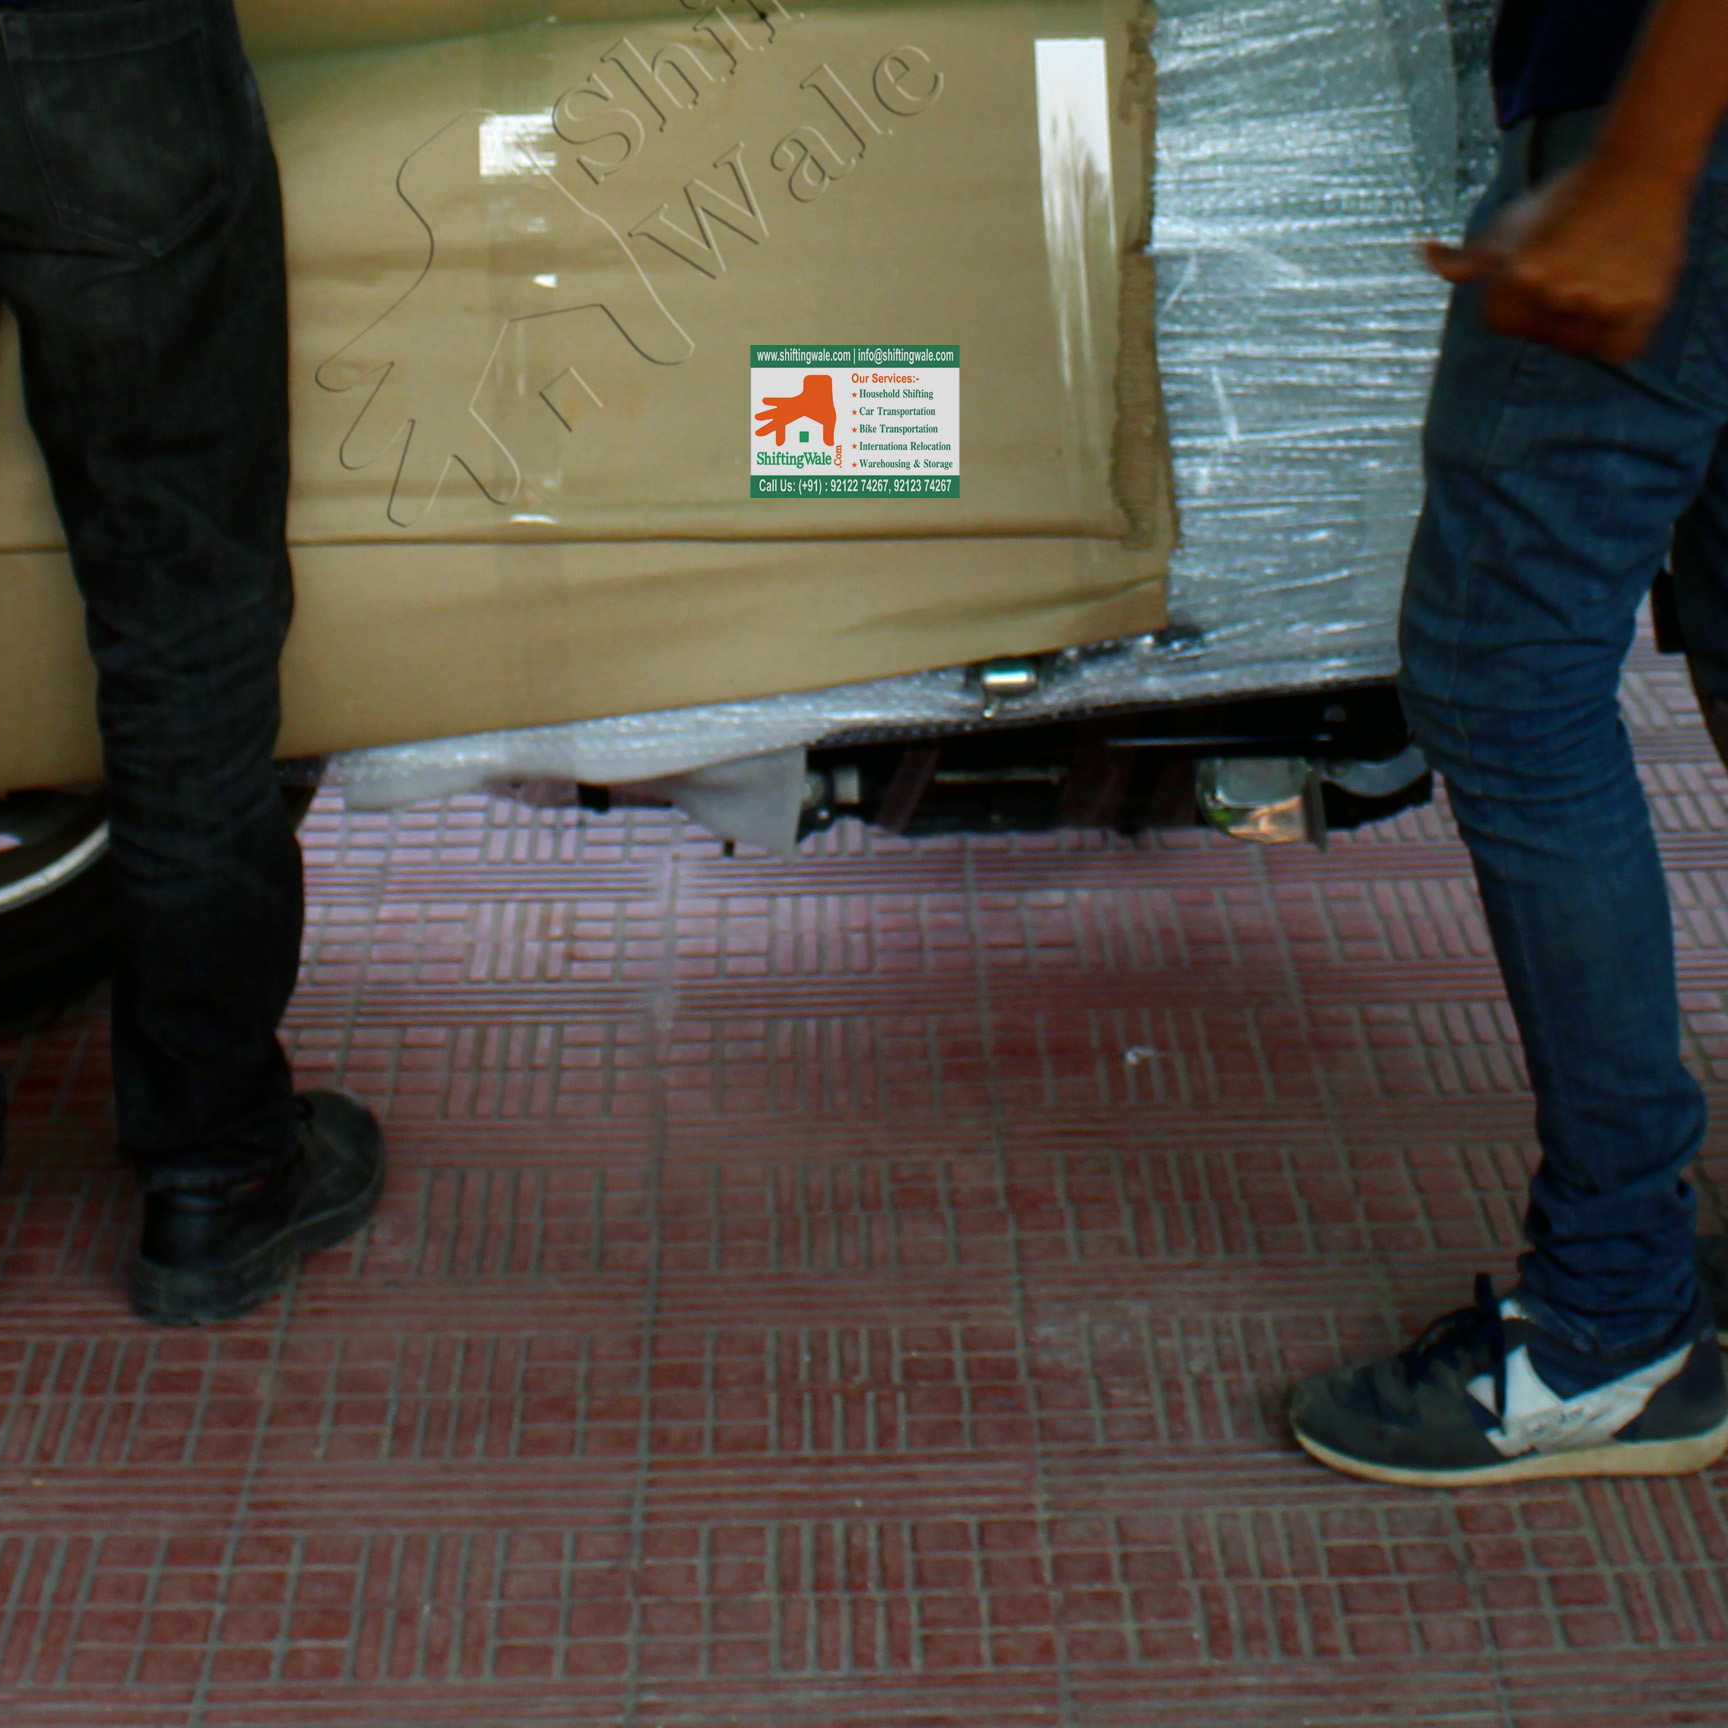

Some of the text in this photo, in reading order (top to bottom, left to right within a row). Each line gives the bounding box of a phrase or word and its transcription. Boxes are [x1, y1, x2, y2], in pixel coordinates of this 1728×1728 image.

[757, 348, 851, 364] www.shiftingwale.com
[858, 348, 954, 364] info@shiftingwale.com
[851, 373, 920, 383] Our Services:-
[859, 389, 934, 400] Household Shifting
[859, 407, 936, 418] Car Transportation
[859, 424, 938, 435] Bike Transportation
[859, 441, 951, 451] Internationa Relocation
[756, 451, 832, 469] ShiftingWale
[834, 445, 842, 468] .Com
[859, 459, 953, 470] Warehousing & Storage
[759, 479, 777, 492] Call
[780, 479, 796, 492] Us:
[798, 478, 822, 495] (+91)
[830, 479, 858, 492] 92122
[861, 479, 891, 494] 74267,
[893, 479, 922, 492] 92123
[924, 479, 952, 492] 74267
